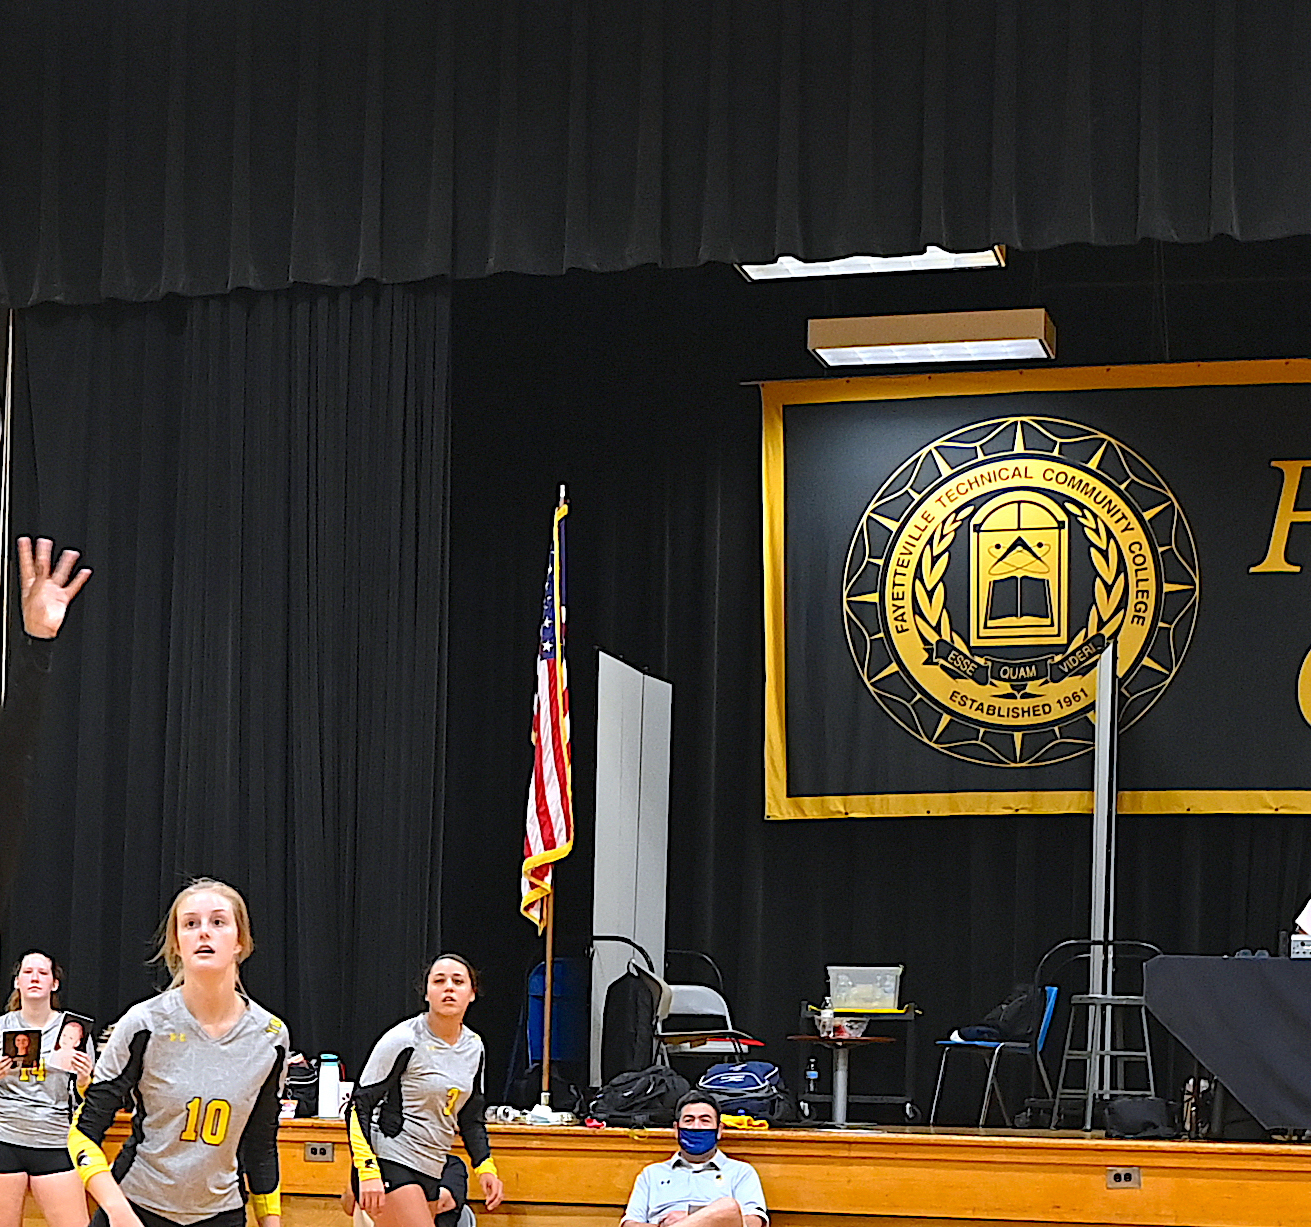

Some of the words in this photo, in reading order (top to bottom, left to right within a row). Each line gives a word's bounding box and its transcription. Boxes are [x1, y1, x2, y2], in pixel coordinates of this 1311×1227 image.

[891, 510, 935, 635] FAYETTEVILLE
[935, 466, 1033, 508] TECHNICAL
[1042, 468, 1135, 535] COMMUNITY
[1128, 541, 1149, 627] COLLEGE
[947, 651, 978, 675] ESSE
[1000, 665, 1037, 678] QUAM
[1058, 642, 1096, 674] VIDERI
[949, 690, 1052, 718] ESTABLISHED
[1056, 688, 1089, 710] 1961
[443, 1088, 461, 1116] 3
[180, 1096, 231, 1146] 10
